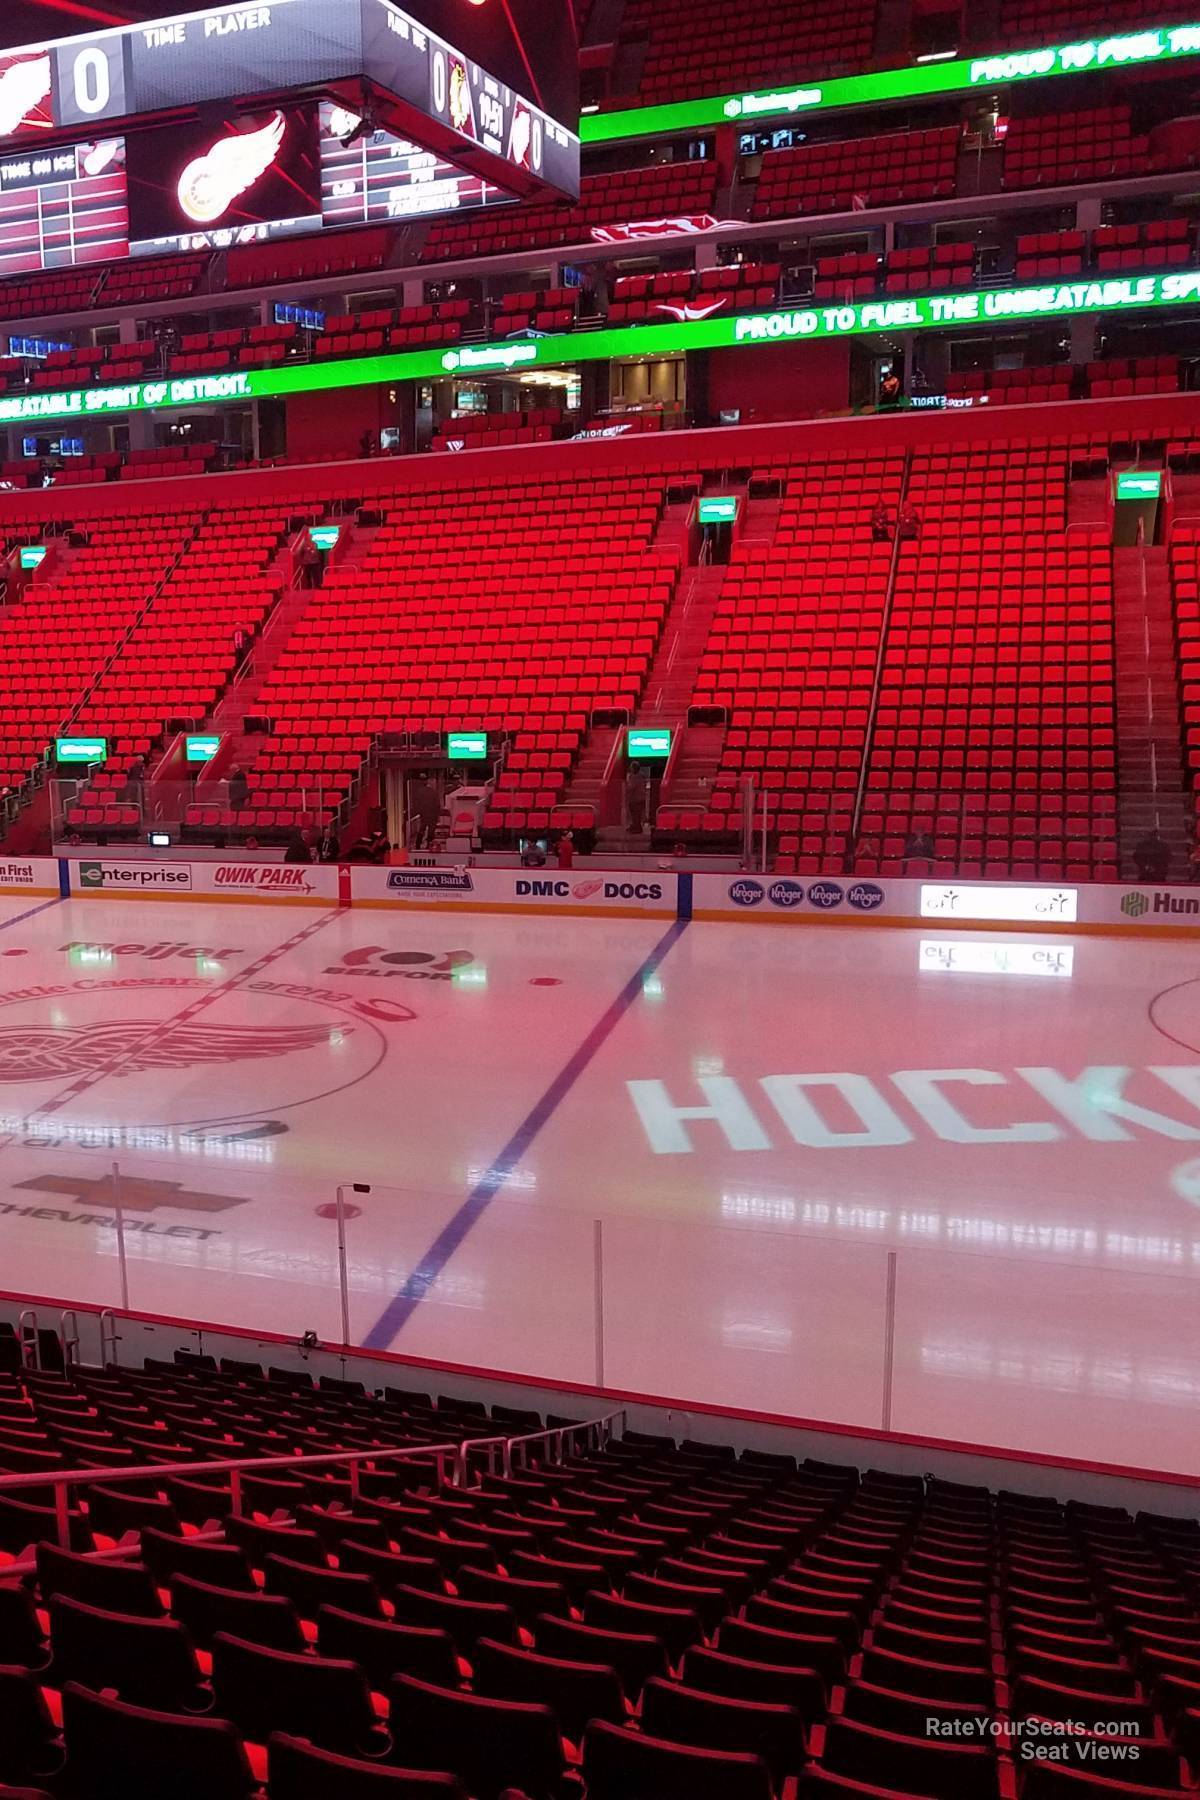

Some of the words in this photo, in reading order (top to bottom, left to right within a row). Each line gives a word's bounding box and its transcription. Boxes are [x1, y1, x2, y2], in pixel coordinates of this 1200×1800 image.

[144, 24, 186, 48] TIME
[204, 7, 271, 37] PLAYER
[971, 50, 1055, 83] PROUD
[1059, 43, 1094, 69] TO
[1098, 32, 1164, 63] FUEL
[74, 48, 110, 113] 0
[1, 162, 32, 181] TIME
[33, 158, 52, 175] ON
[53, 154, 75, 171] ICE
[735, 315, 817, 340] PROUD
[823, 307, 856, 331] TO
[861, 301, 924, 328] FUEL
[930, 294, 979, 321] THE
[984, 277, 1156, 315] UNBEATABLE
[85, 384, 141, 410] SPIRIT
[143, 382, 168, 404] OF
[171, 374, 252, 402] DETROIT.
[7, 864, 34, 877] First
[82, 867, 190, 885] enterprise
[214, 867, 258, 884] QWIK
[259, 868, 308, 885] PARK
[441, 874, 466, 886] Bank
[515, 880, 570, 897] DMC
[603, 882, 663, 900] DOCS
[732, 884, 763, 904] Kroger
[771, 884, 802, 905] Kroger
[810, 885, 842, 906] Kroger
[850, 887, 882, 908] Kroger
[57, 940, 245, 960] meijer
[320, 966, 457, 981] BELFOR
[72, 975, 215, 992] Caesars
[247, 978, 354, 1002] arena
